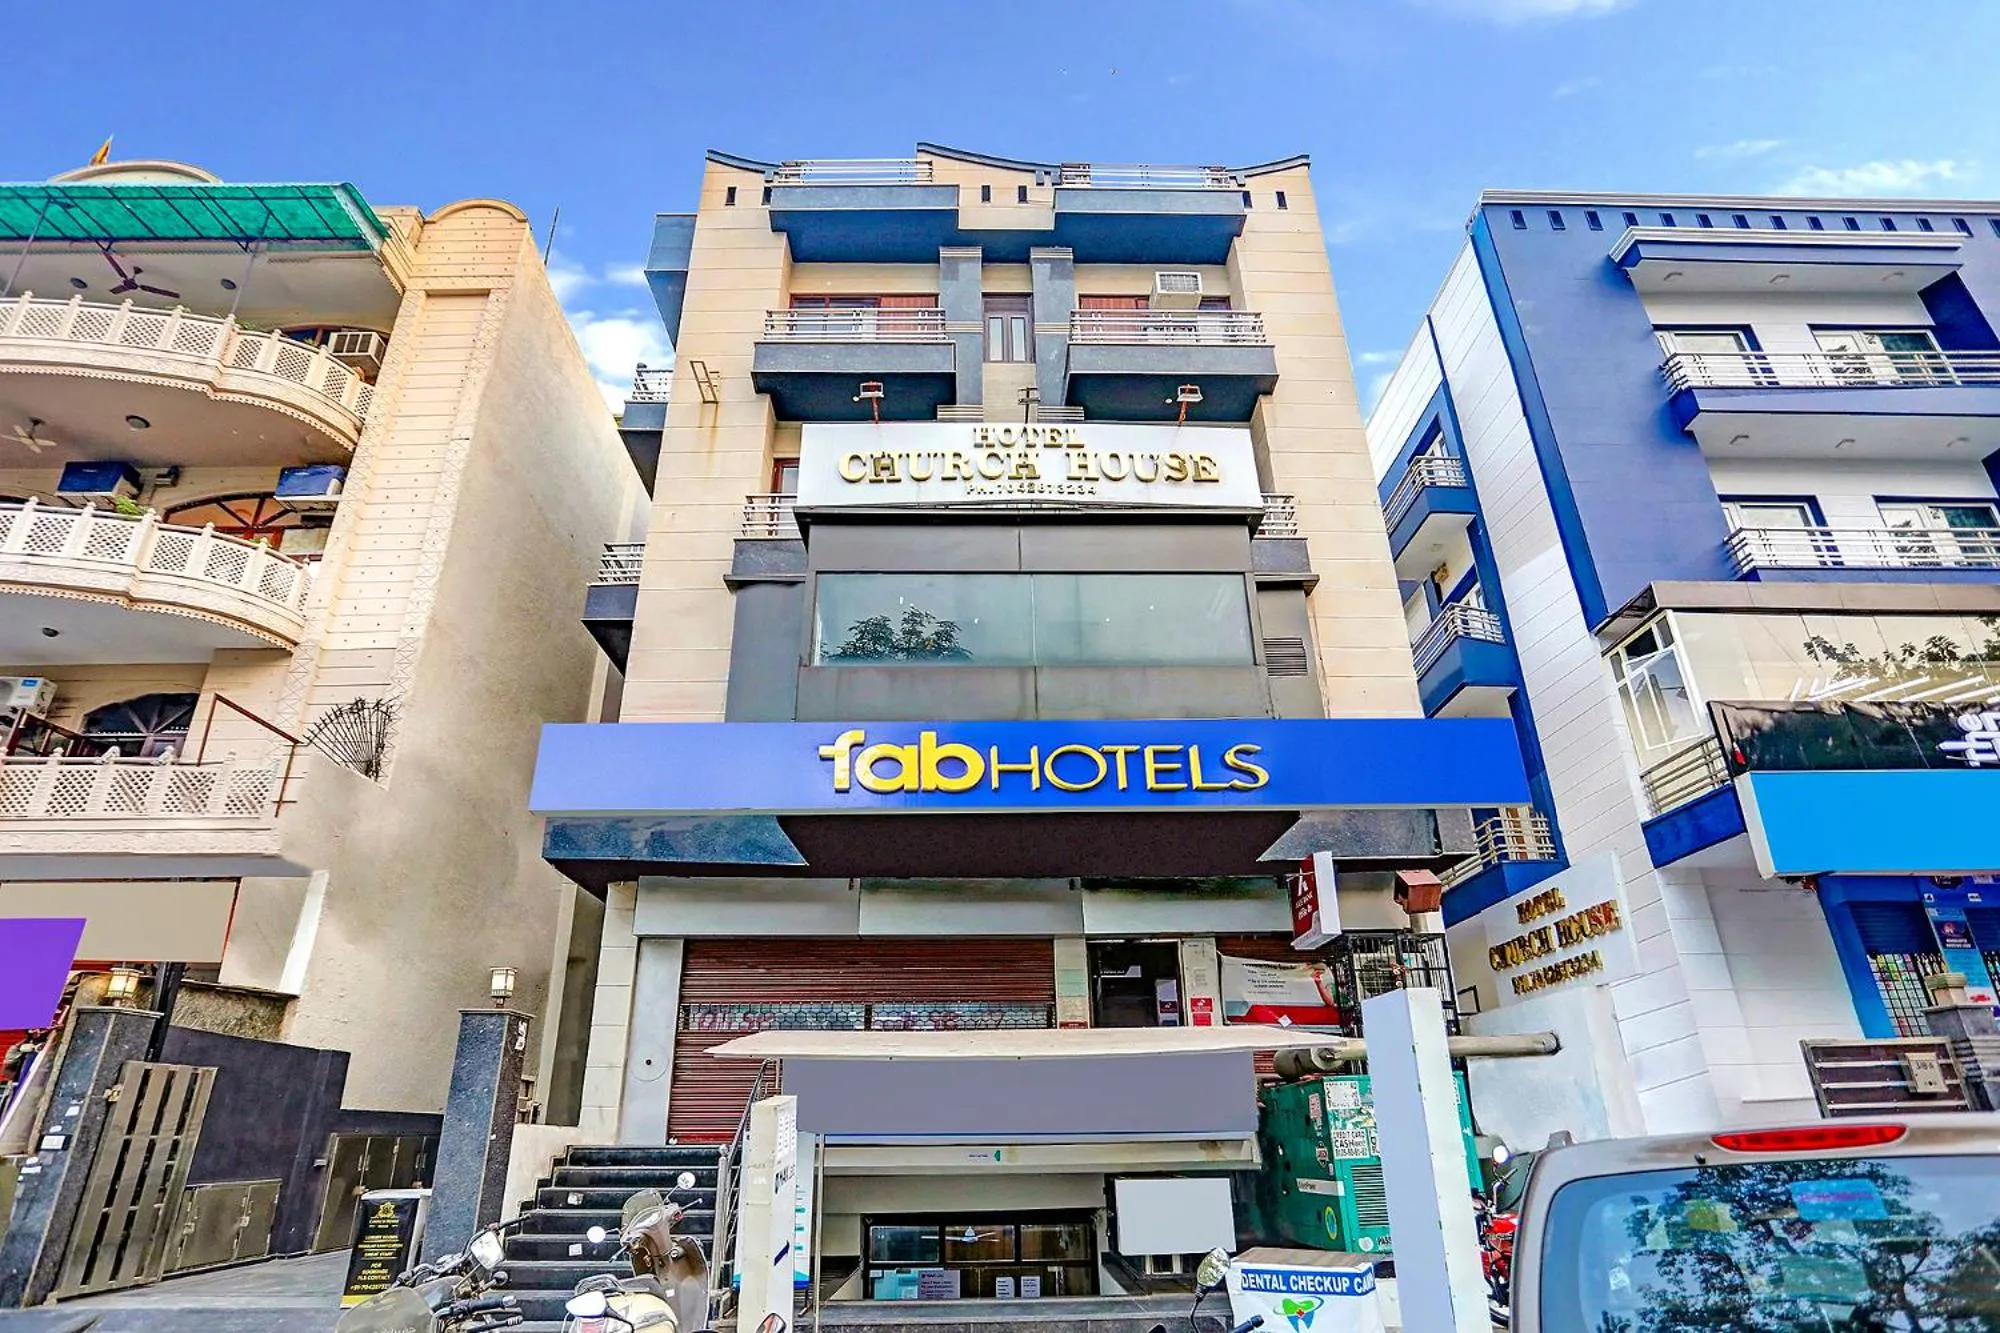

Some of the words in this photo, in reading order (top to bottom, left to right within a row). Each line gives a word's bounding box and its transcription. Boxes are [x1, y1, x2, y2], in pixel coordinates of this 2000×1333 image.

[973, 426, 1085, 448] HOTEL
[838, 450, 1041, 483] CHURCH
[1064, 450, 1220, 483] HOUSE
[1489, 926, 1556, 972] CHURCH
[1554, 900, 1623, 949] HOUSE
[1241, 1273, 1287, 1291] DENTAL
[1289, 1275, 1350, 1293] CHECKUP
